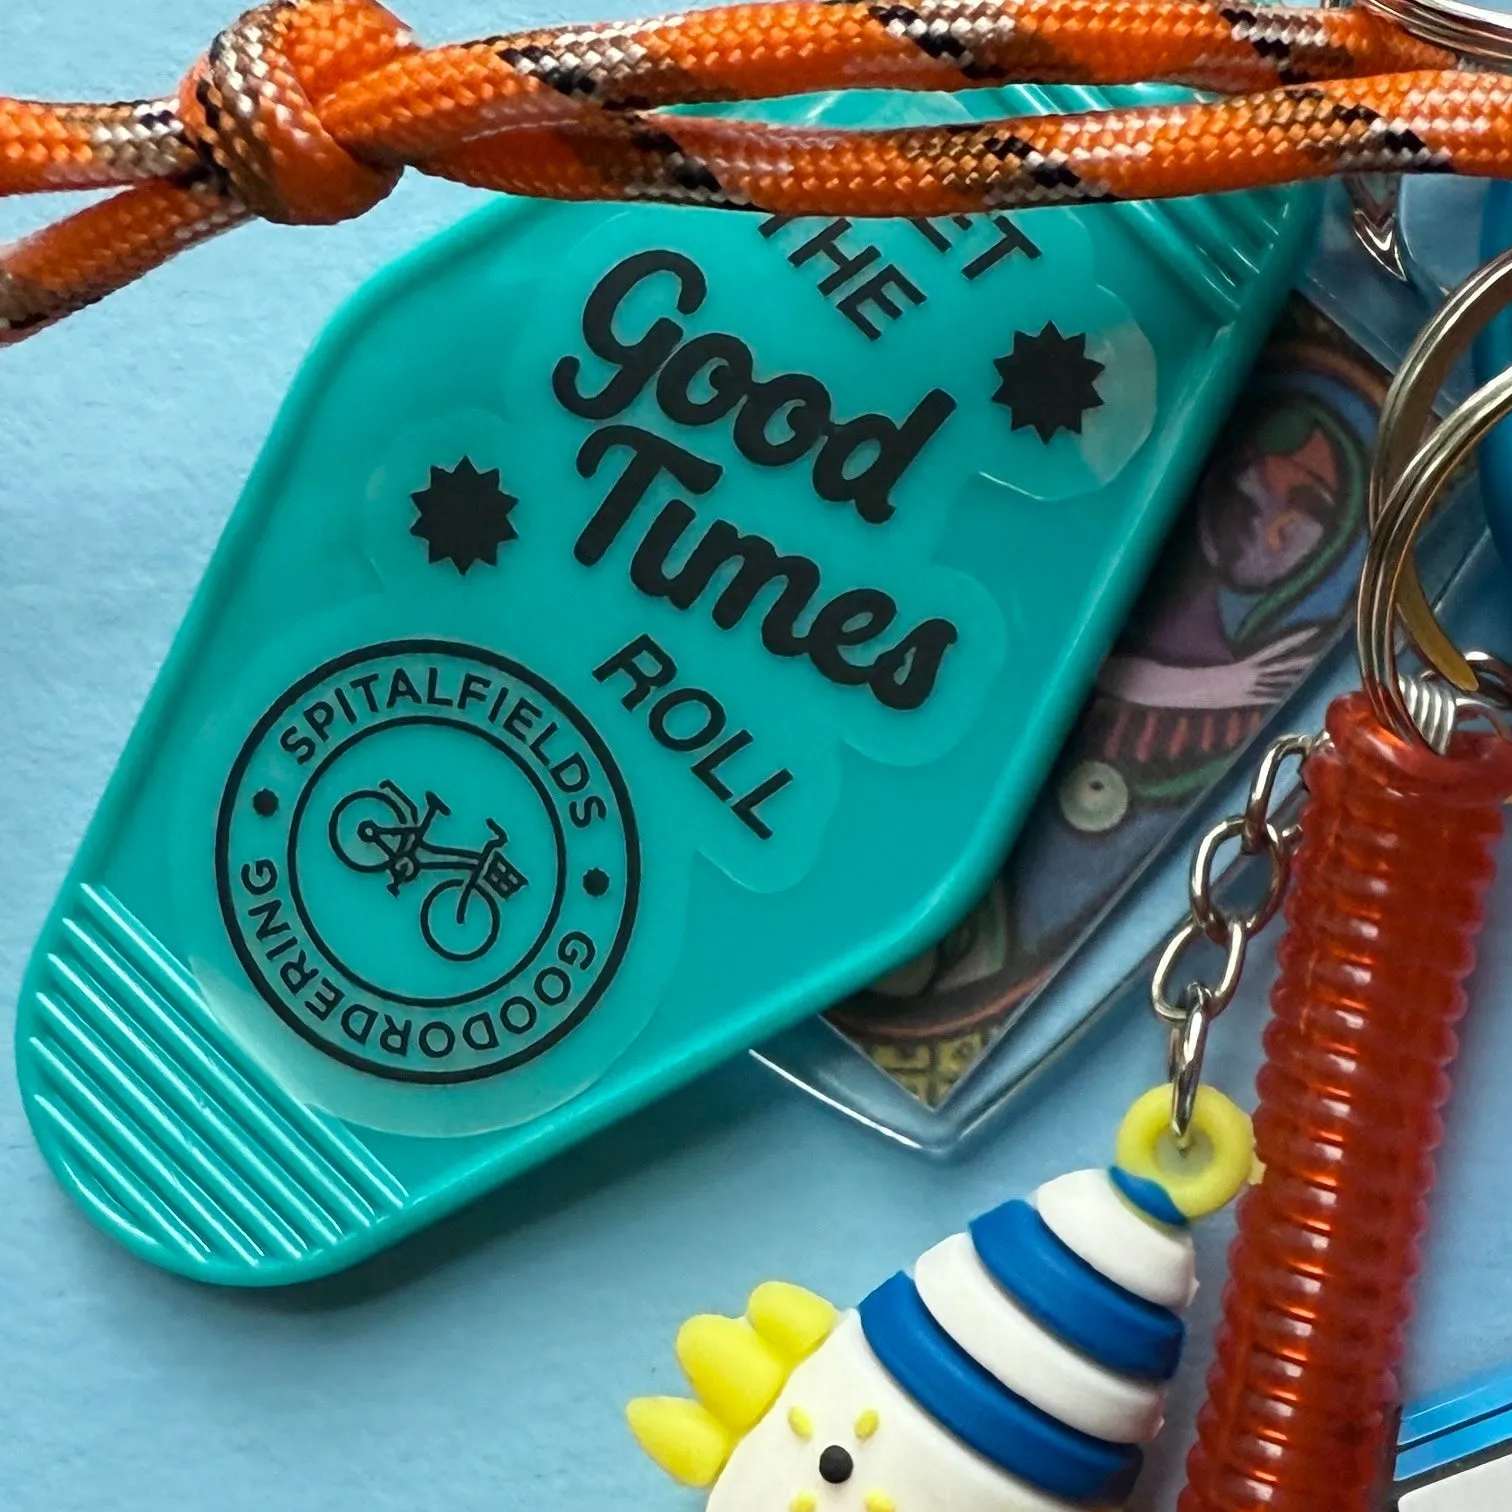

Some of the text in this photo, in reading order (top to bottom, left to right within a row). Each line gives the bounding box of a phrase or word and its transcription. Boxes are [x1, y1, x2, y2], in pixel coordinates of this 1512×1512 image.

[552, 249, 958, 525] Good
[573, 425, 959, 711] Times
[279, 667, 607, 828] SPITALFIELDS
[591, 633, 794, 840] ROLL
[240, 858, 596, 1059] GOODORDERING
